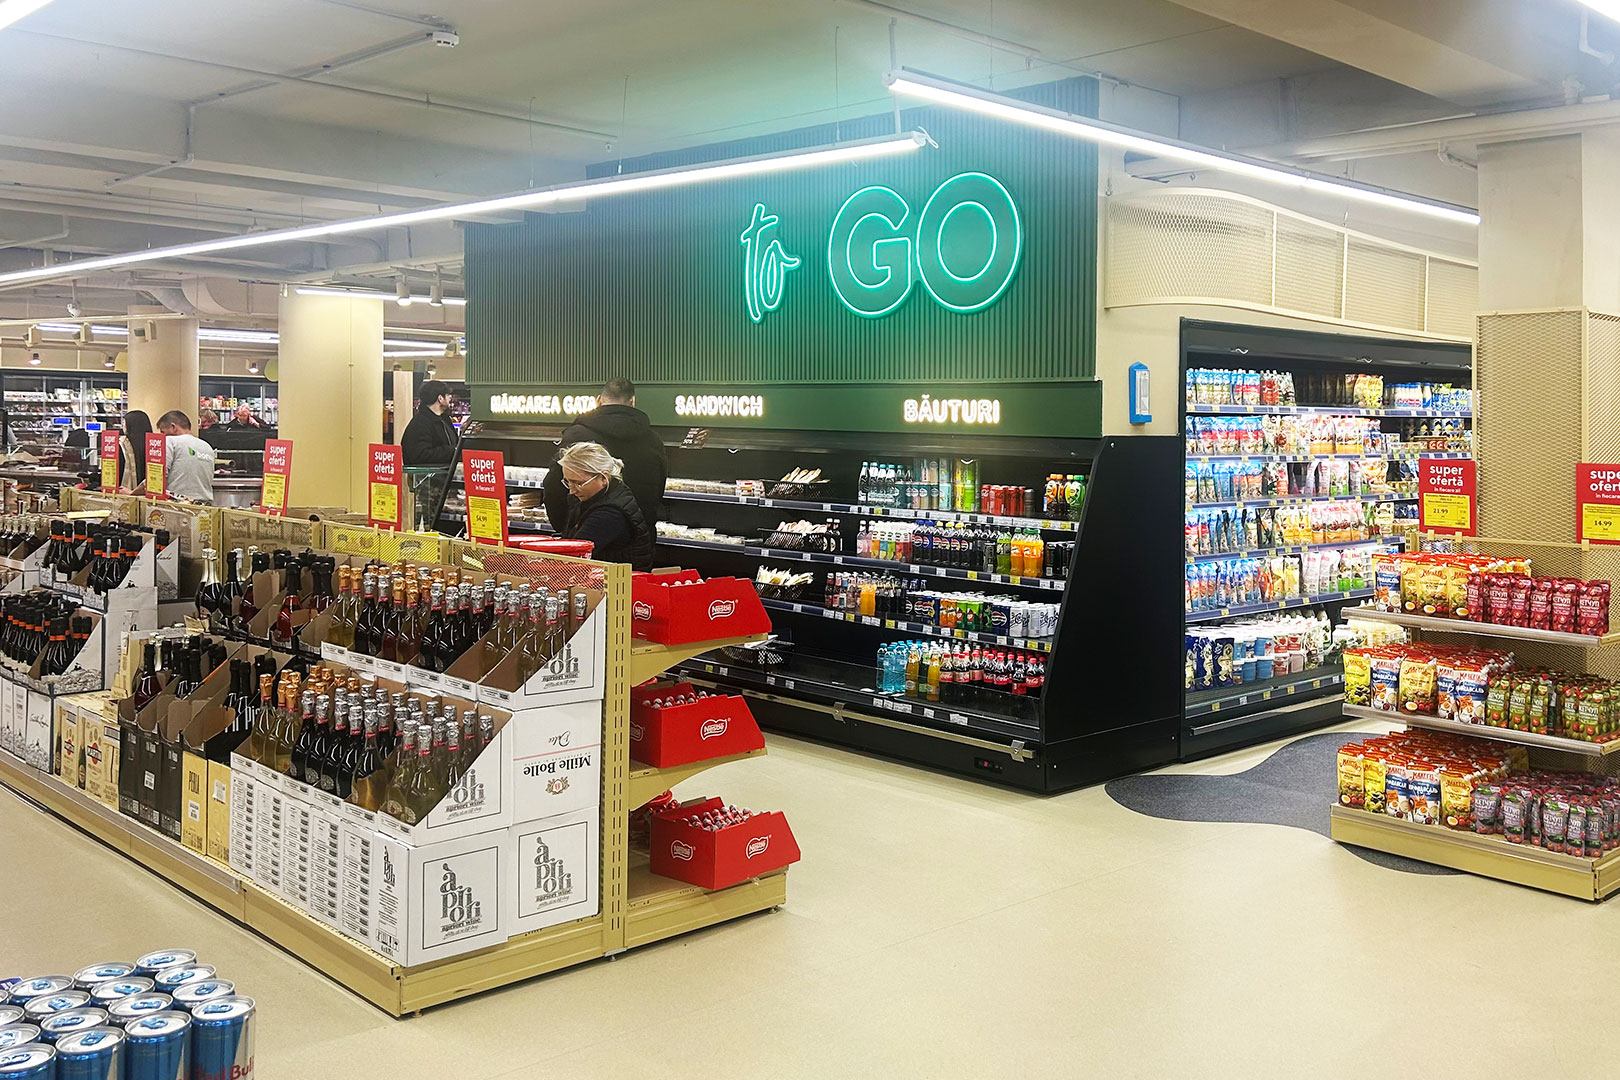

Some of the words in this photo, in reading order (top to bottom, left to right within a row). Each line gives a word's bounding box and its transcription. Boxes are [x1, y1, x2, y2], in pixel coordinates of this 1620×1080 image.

[741, 203, 800, 321] to
[828, 171, 1021, 316] GO
[675, 395, 764, 417] SANDWICH
[903, 394, 1000, 423] BĂUTURI
[374, 451, 395, 463] super
[470, 459, 495, 471] super
[1430, 465, 1464, 477] super
[471, 470, 496, 484] ofertă
[1429, 475, 1464, 487] ofertă
[1590, 470, 1620, 482] supe
[523, 762, 556, 777] Bolle
[560, 755, 591, 770] Mille
